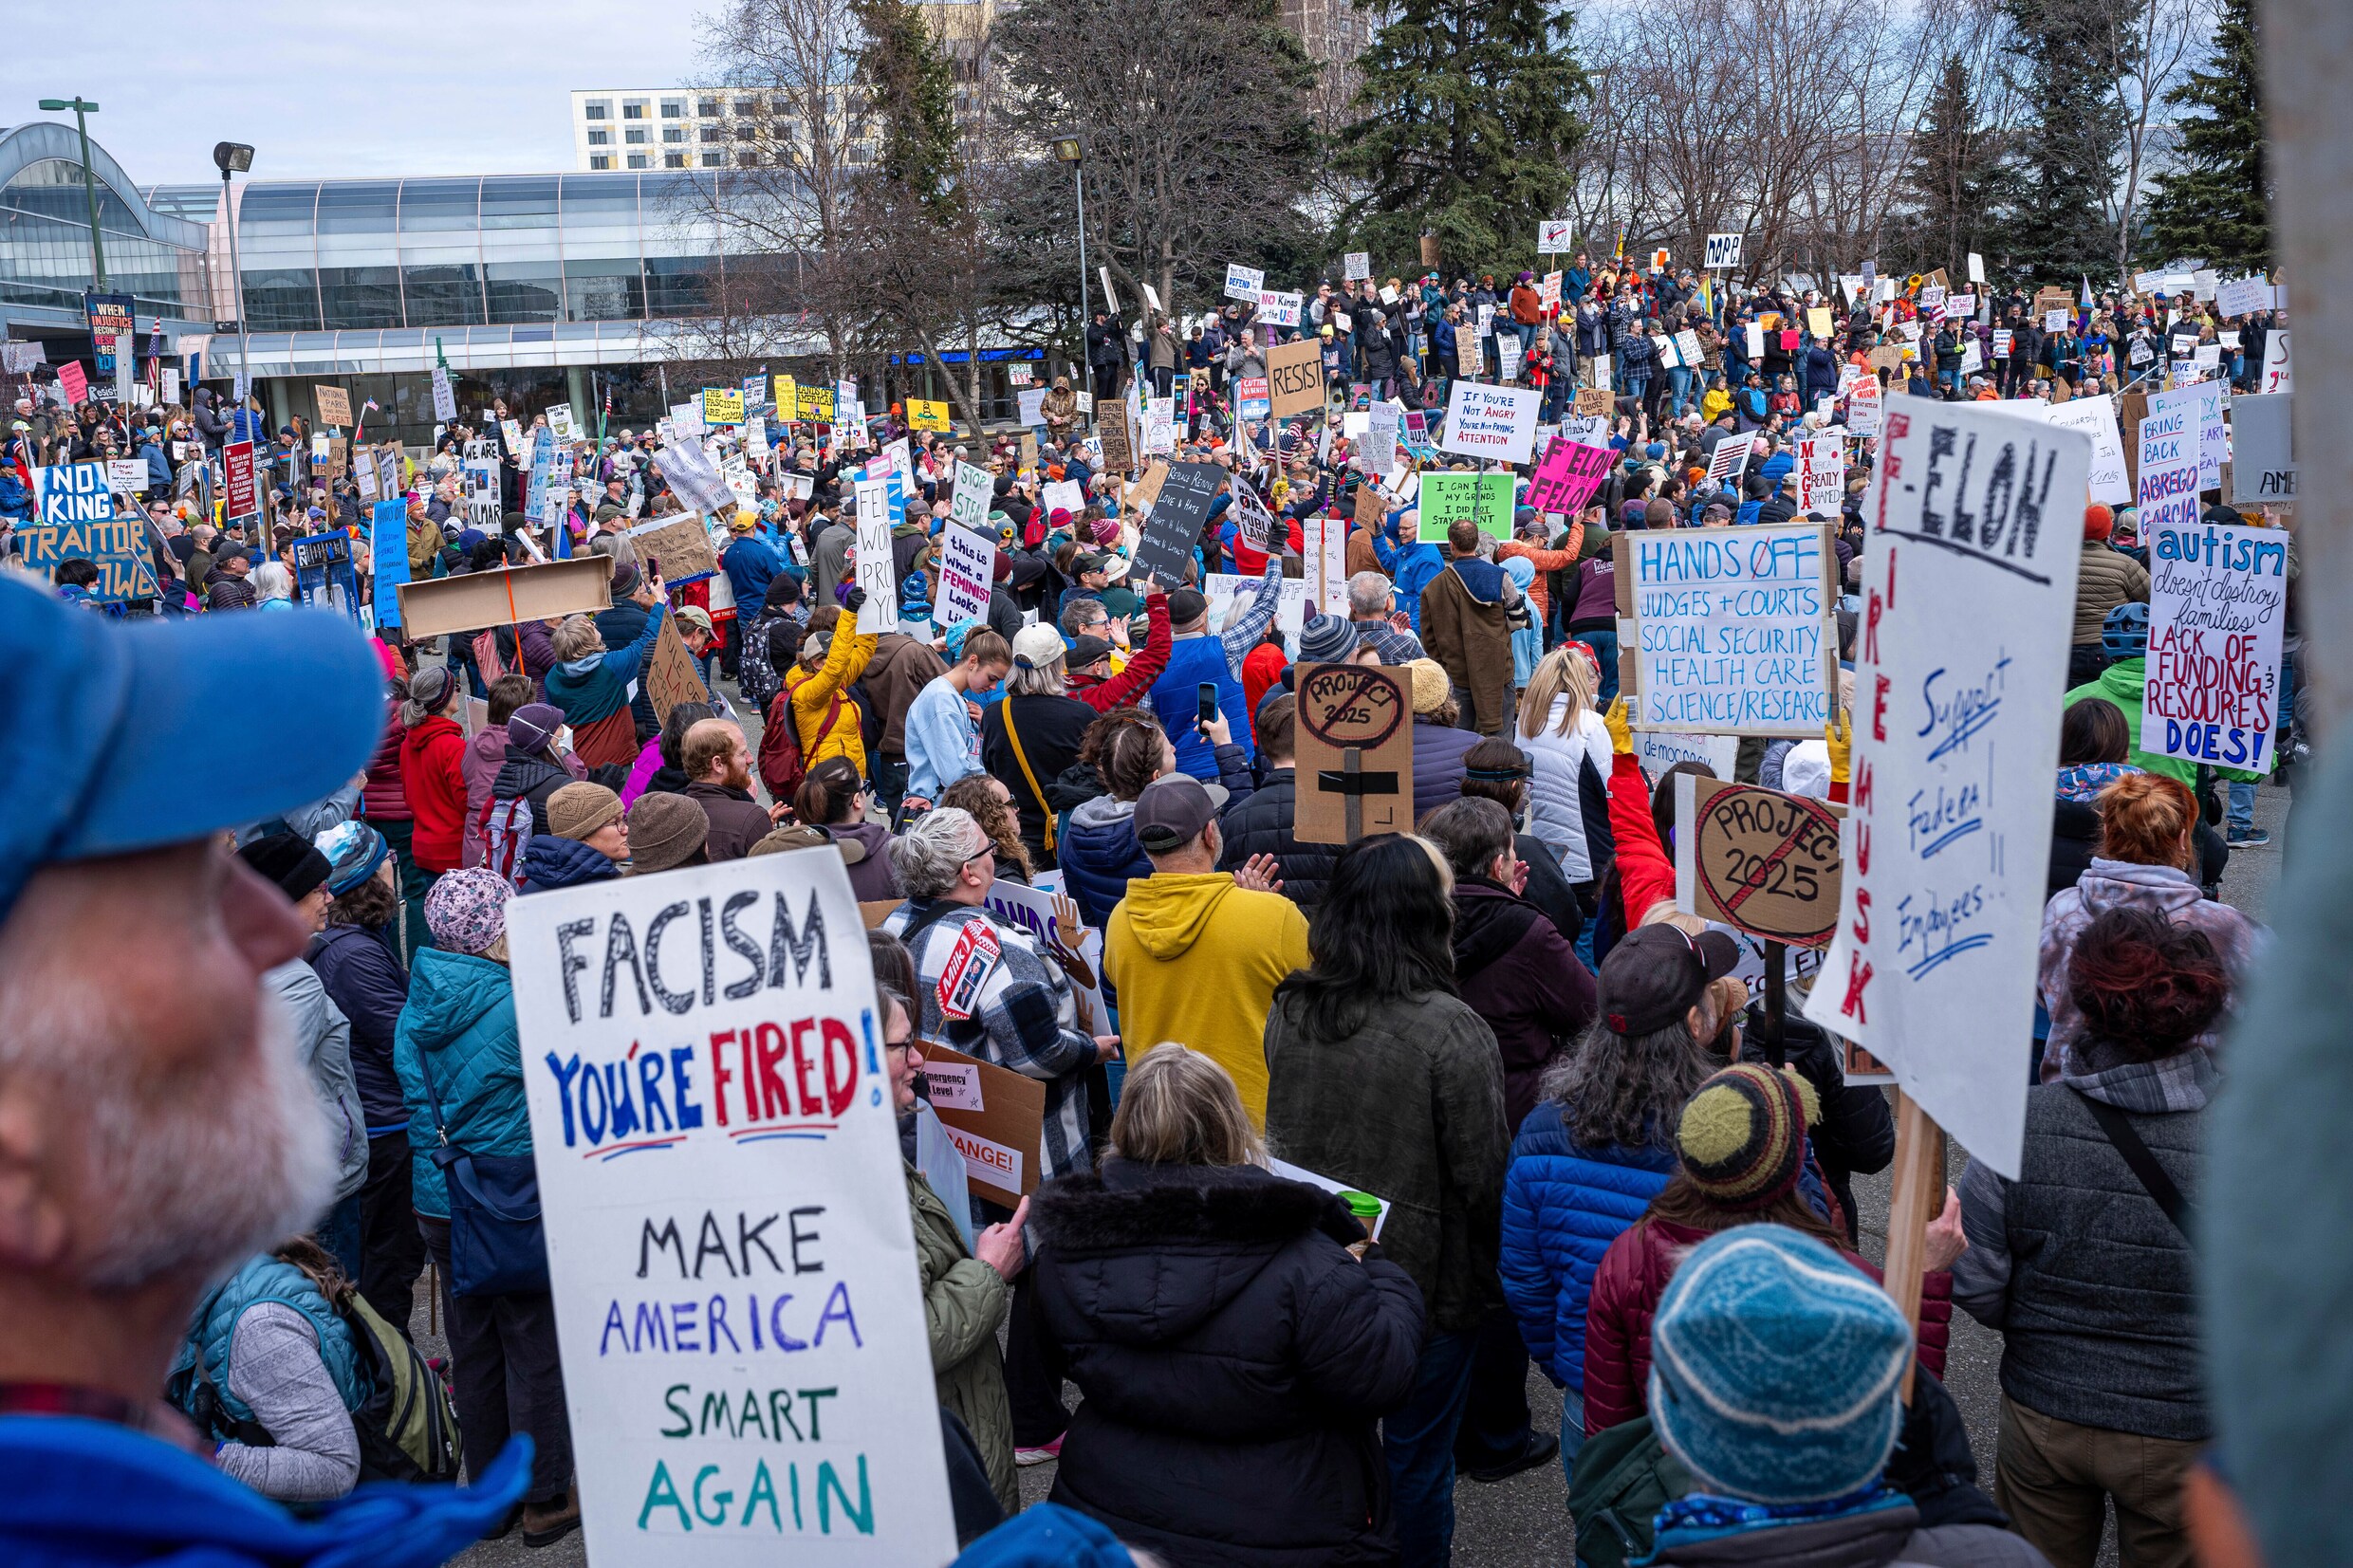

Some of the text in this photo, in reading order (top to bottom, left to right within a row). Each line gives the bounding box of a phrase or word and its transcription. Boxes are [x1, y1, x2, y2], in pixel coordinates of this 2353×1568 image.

[1707, 236, 1739, 265] nope.
[1229, 277, 1250, 288] DEFEND
[97, 304, 125, 316] WHEN
[1262, 294, 1298, 308] NO Kings
[91, 316, 133, 327] INJUSTICE
[1268, 309, 1278, 319] the
[796, 385, 820, 396] HANDS
[1273, 360, 1321, 397] RESIST
[319, 387, 346, 399] NATIONAL
[325, 399, 347, 409] PARKS
[705, 389, 721, 398] THE
[706, 398, 741, 409] FASCISTS
[797, 395, 834, 406] AMERICAN
[1463, 392, 1514, 406] IF YOU'RE
[325, 415, 351, 424] GREAT
[705, 408, 720, 416] ARE
[1100, 412, 1122, 421] EATING
[1463, 405, 1515, 419] NOT ANGRY
[1459, 418, 1514, 434] YOU'RE NOT PAYING
[2144, 414, 2183, 438] BRING
[2207, 425, 2223, 440] ART
[1457, 432, 1508, 445] ATTENTION
[331, 446, 345, 459] STOP
[465, 442, 498, 461] WE ARE
[2144, 440, 2179, 463] BACK
[52, 465, 95, 494] NO
[315, 465, 345, 474] TRMP
[960, 465, 987, 489] STOP
[1191, 471, 1214, 490] REMOVE
[1436, 482, 1470, 491] I CAN
[1578, 478, 1590, 487] THE
[2139, 465, 2198, 507] ABREGO
[47, 493, 110, 524] KING
[1158, 490, 1199, 514] LOVE HATE
[1465, 492, 1495, 501] GRNDS
[468, 503, 501, 526] KILMAR
[1240, 510, 1270, 532] PUBLI
[1432, 515, 1454, 525] STAY
[1445, 506, 1451, 514] I
[2140, 497, 2198, 535] GARCIA
[17, 520, 146, 563] TRAITOR
[951, 536, 987, 565] this is
[2157, 526, 2285, 576] autism
[945, 553, 983, 582] what a
[1641, 534, 1820, 582] HANDS OFF
[943, 568, 991, 604] FEMINIST
[2154, 562, 2280, 623] doesn't destroy
[949, 589, 977, 615] Looks
[1640, 587, 1820, 617] JUDGES COURTS
[2173, 598, 2255, 638] families
[1641, 625, 1820, 658] SOCIAL SECURITY
[2149, 625, 2257, 662] LACK OF
[662, 621, 701, 702] RULE OF
[1656, 657, 1816, 687] HEALTH CARE
[2158, 652, 2261, 693] FUNDING
[1917, 645, 2012, 753] Support
[2167, 719, 2266, 767] DOES!
[1725, 848, 1819, 902] 2025
[1841, 756, 1875, 1026] MUSK
[555, 887, 834, 1024] FACISM
[973, 947, 994, 964] MISSING
[942, 951, 967, 995] Milk
[546, 1006, 884, 1149] YOU'RE FIRED!
[933, 1086, 953, 1097] Level
[949, 1131, 1013, 1172] ANGE!
[636, 1206, 828, 1281] MAKE
[599, 1282, 864, 1357] AMERICA
[660, 1384, 840, 1444] SMART
[638, 1453, 876, 1537] AGAIN
